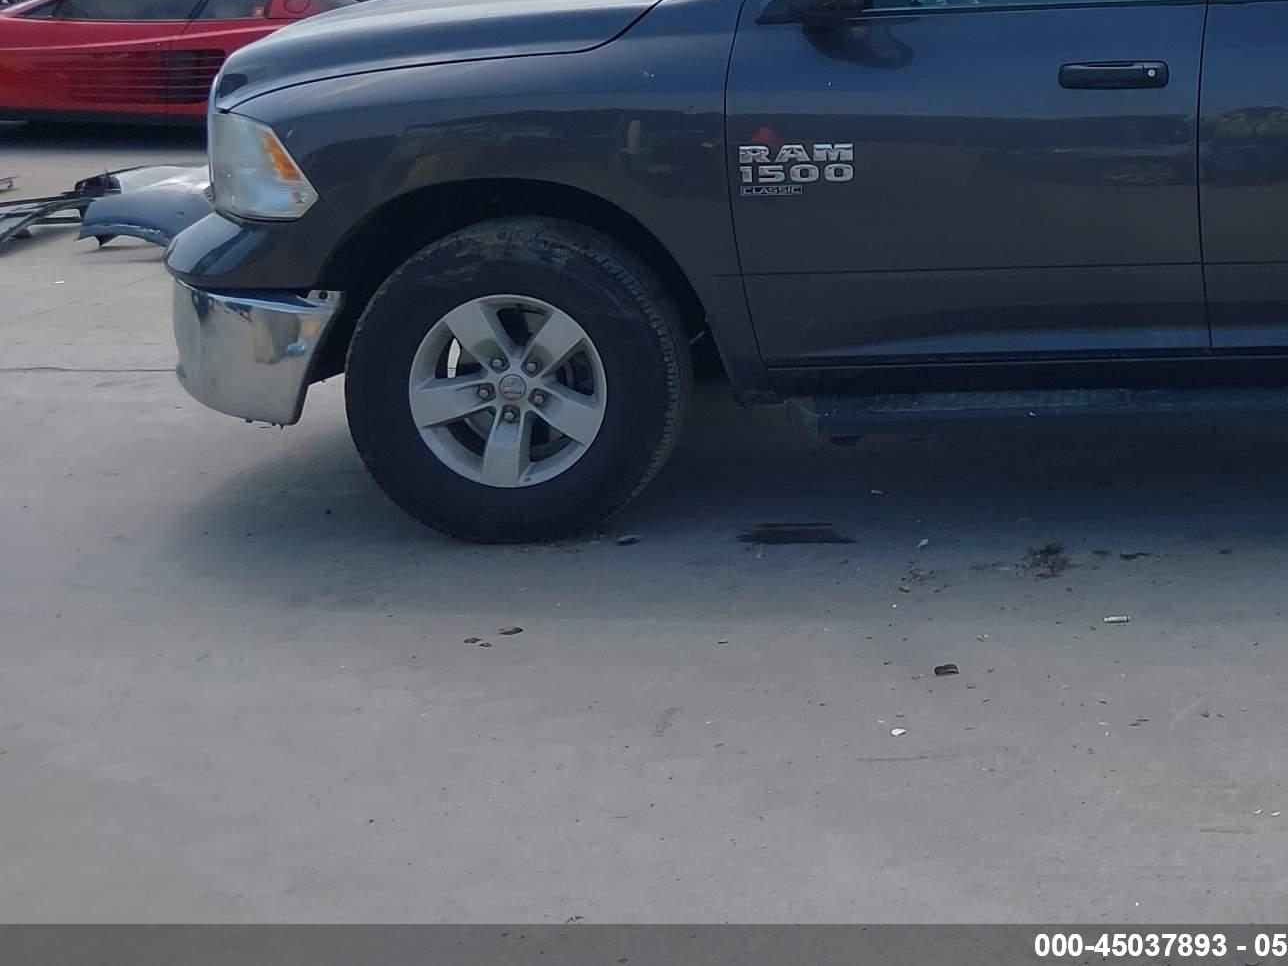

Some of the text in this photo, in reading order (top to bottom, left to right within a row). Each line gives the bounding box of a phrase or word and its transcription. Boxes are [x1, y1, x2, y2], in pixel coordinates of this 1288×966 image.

[739, 143, 853, 163] RAM
[740, 164, 854, 183] 1500
[741, 185, 803, 196] CLASSIC
